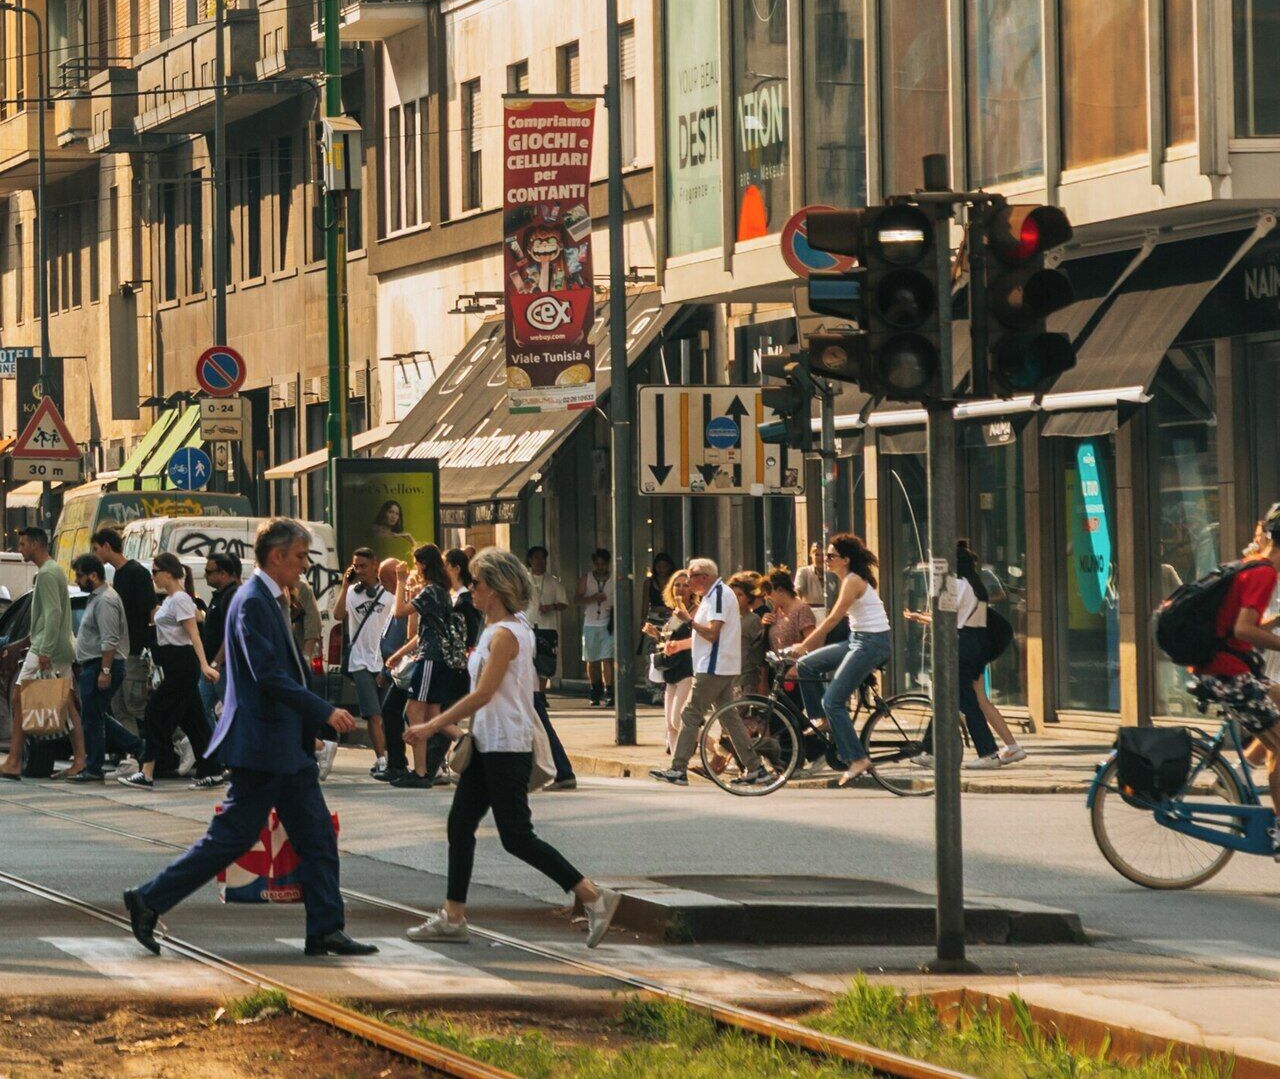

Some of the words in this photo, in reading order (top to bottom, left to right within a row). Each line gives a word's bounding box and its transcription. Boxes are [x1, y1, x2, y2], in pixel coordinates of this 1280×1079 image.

[700, 60, 719, 88] BEAU
[508, 115, 591, 129] Compriamo
[508, 132, 576, 151] GIOCHI
[579, 139, 589, 148] e
[678, 105, 719, 170] DESTI
[507, 153, 588, 170] CELLULARI
[534, 170, 558, 183] per
[507, 184, 585, 203] CONTANTI
[530, 333, 566, 342] webuy.com
[511, 353, 541, 364] Viale
[543, 350, 582, 363] Tunisia
[584, 350, 591, 360] 4
[29, 465, 46, 475] 30
[52, 468, 64, 476] m
[383, 483, 425, 495] Yellow.
